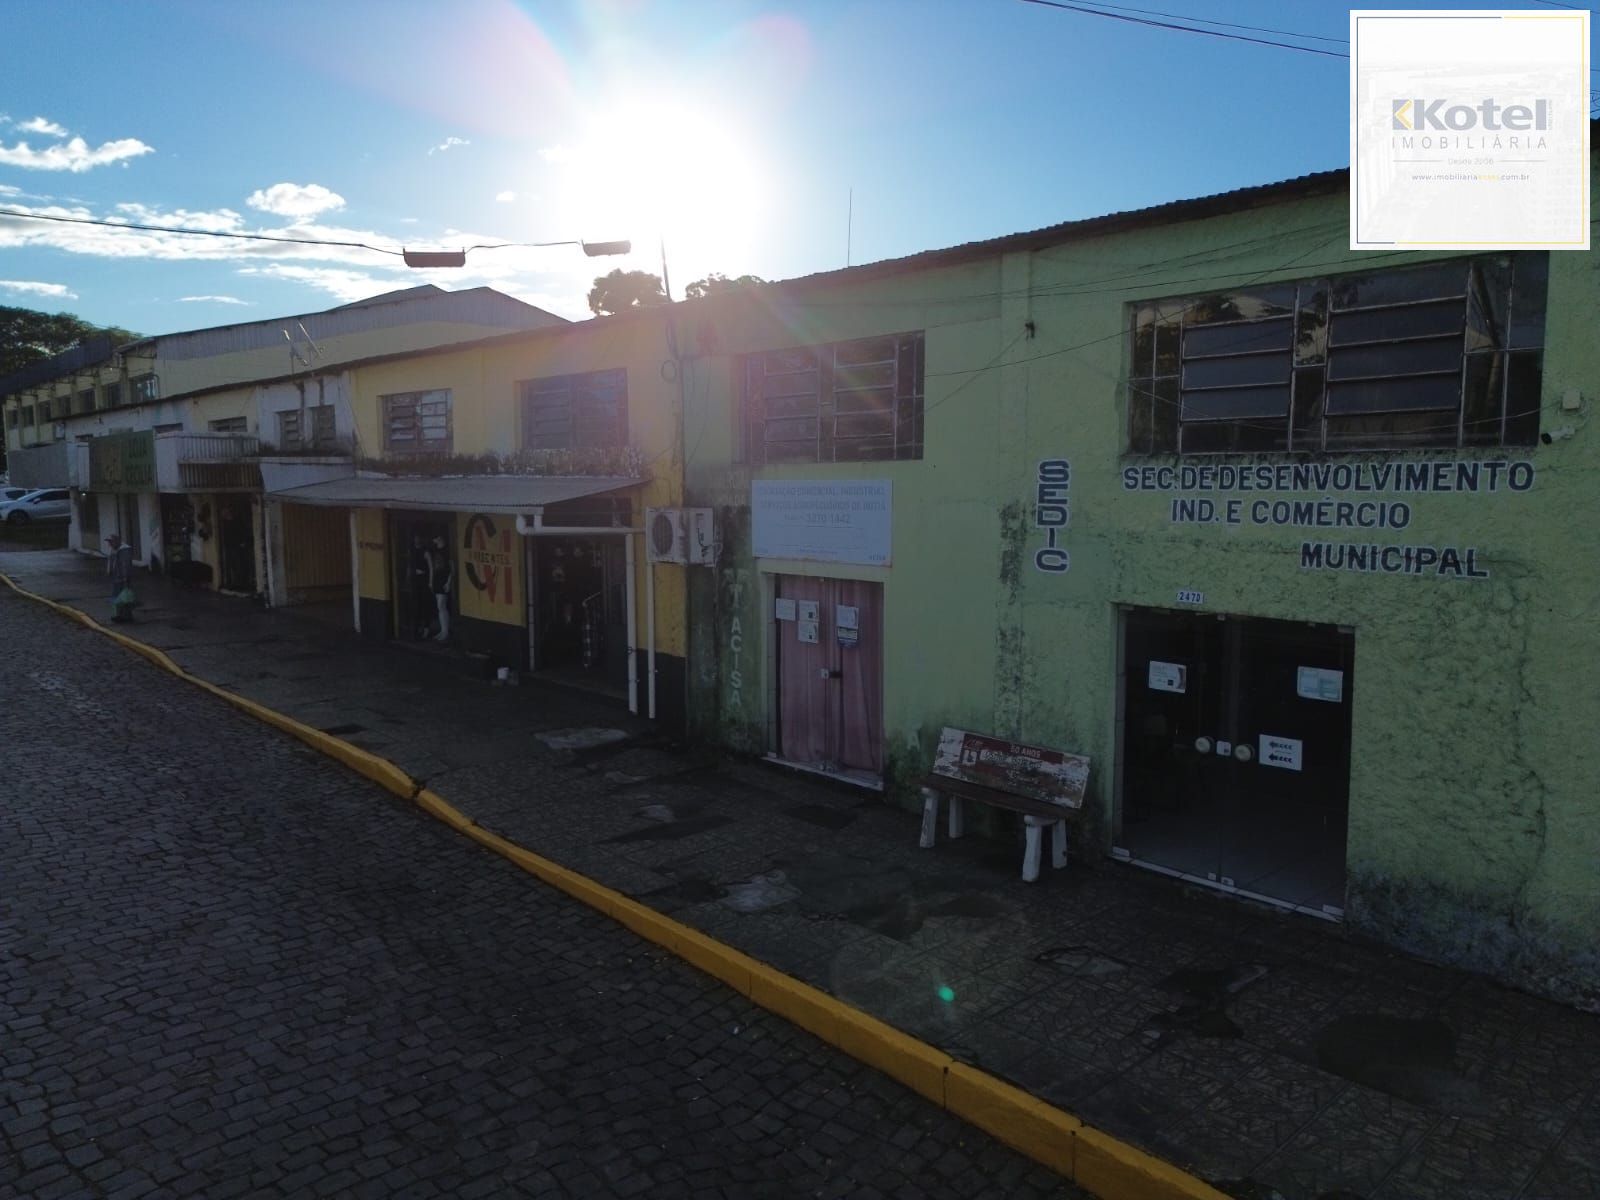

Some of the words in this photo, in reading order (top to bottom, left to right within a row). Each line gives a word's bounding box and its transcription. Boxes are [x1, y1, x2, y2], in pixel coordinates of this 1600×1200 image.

[1036, 460, 1070, 572] SEDIC
[1226, 500, 1243, 523] E
[1251, 497, 1411, 528] COMÉRCIO
[1301, 542, 1489, 577] MUNICIPAL
[1179, 591, 1201, 602] 2470
